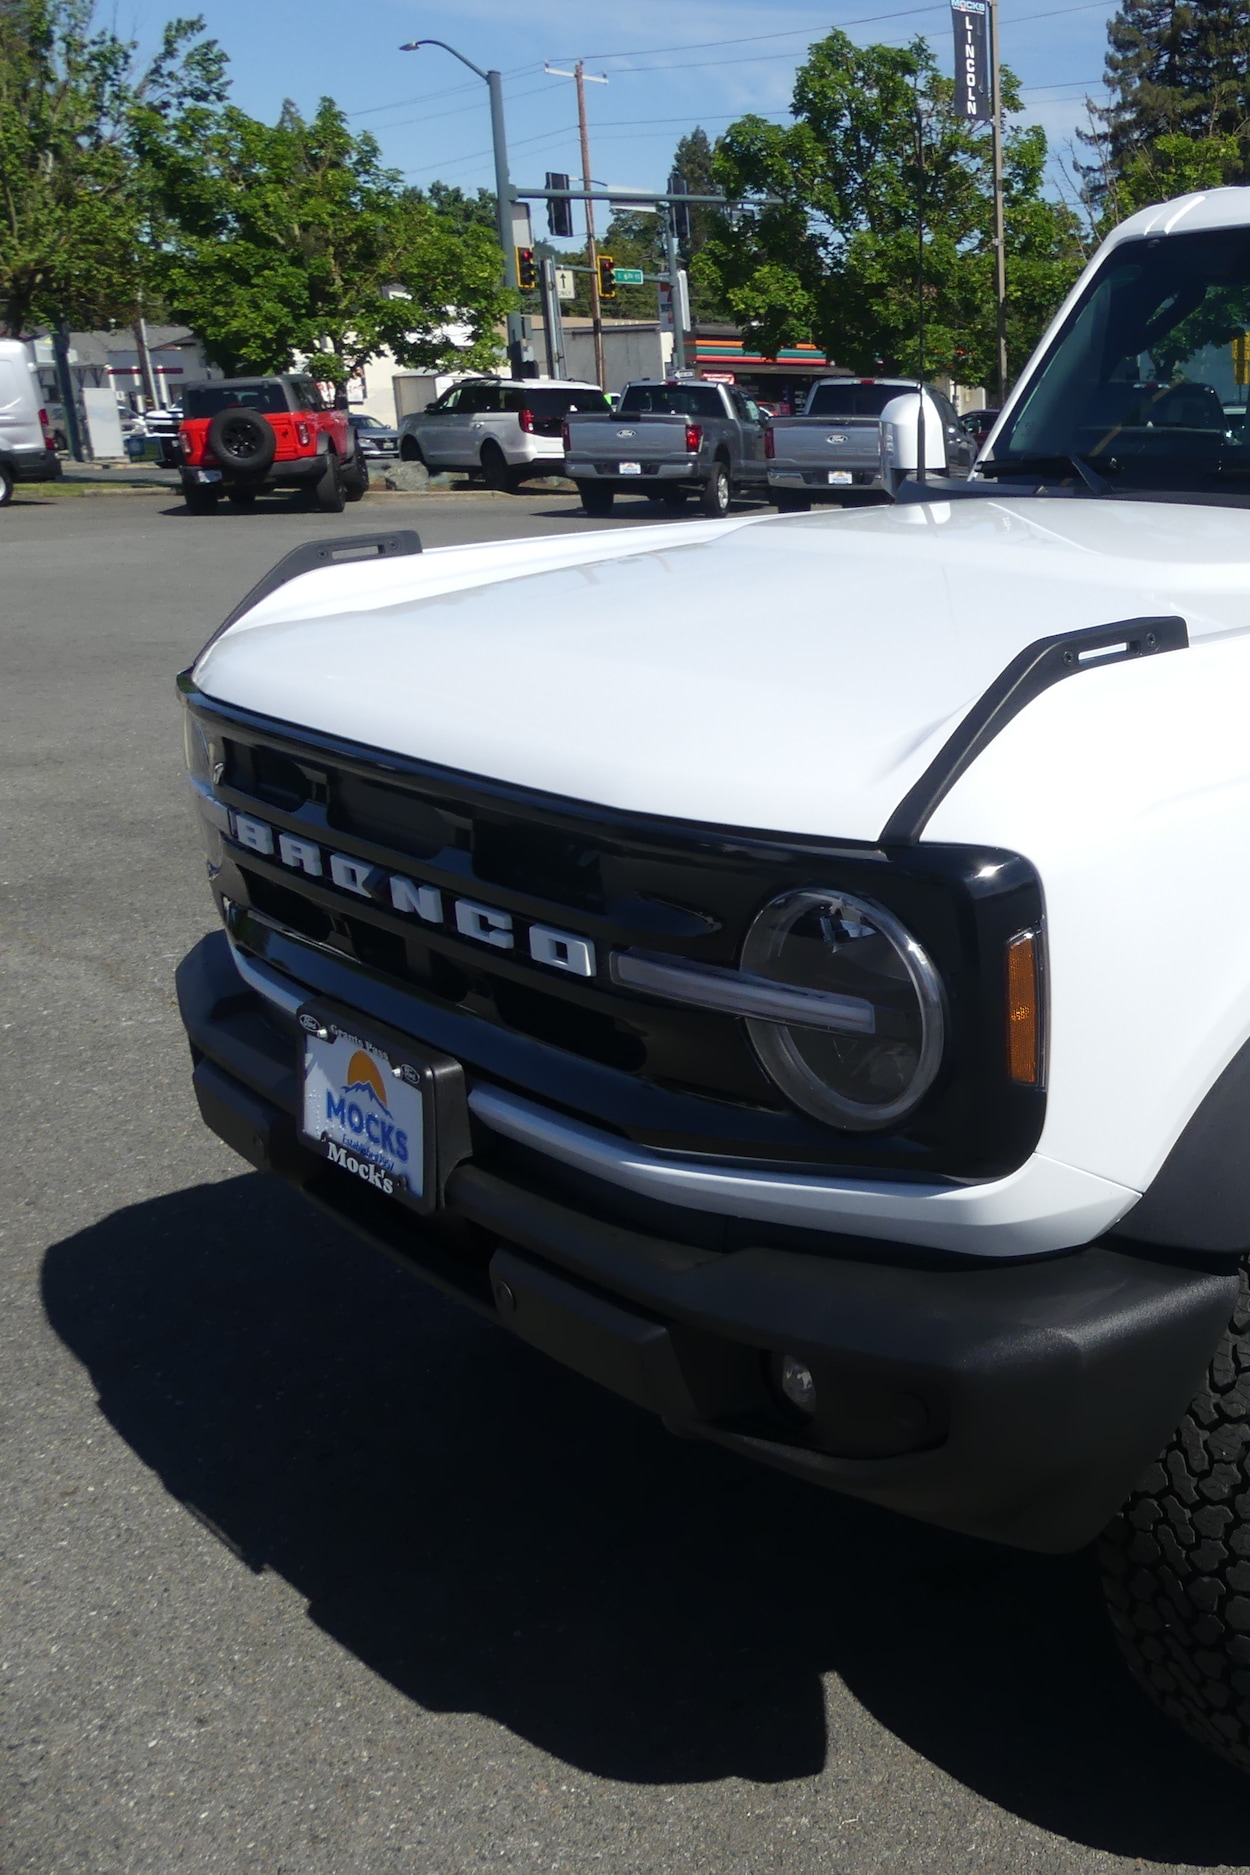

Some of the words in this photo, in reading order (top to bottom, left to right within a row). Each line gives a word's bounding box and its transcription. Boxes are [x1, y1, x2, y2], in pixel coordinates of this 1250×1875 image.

[965, 16, 977, 115] LINCOLN
[234, 811, 598, 978] BRONCO
[326, 1089, 410, 1163] MOCKS
[327, 1141, 394, 1194] Mock's
